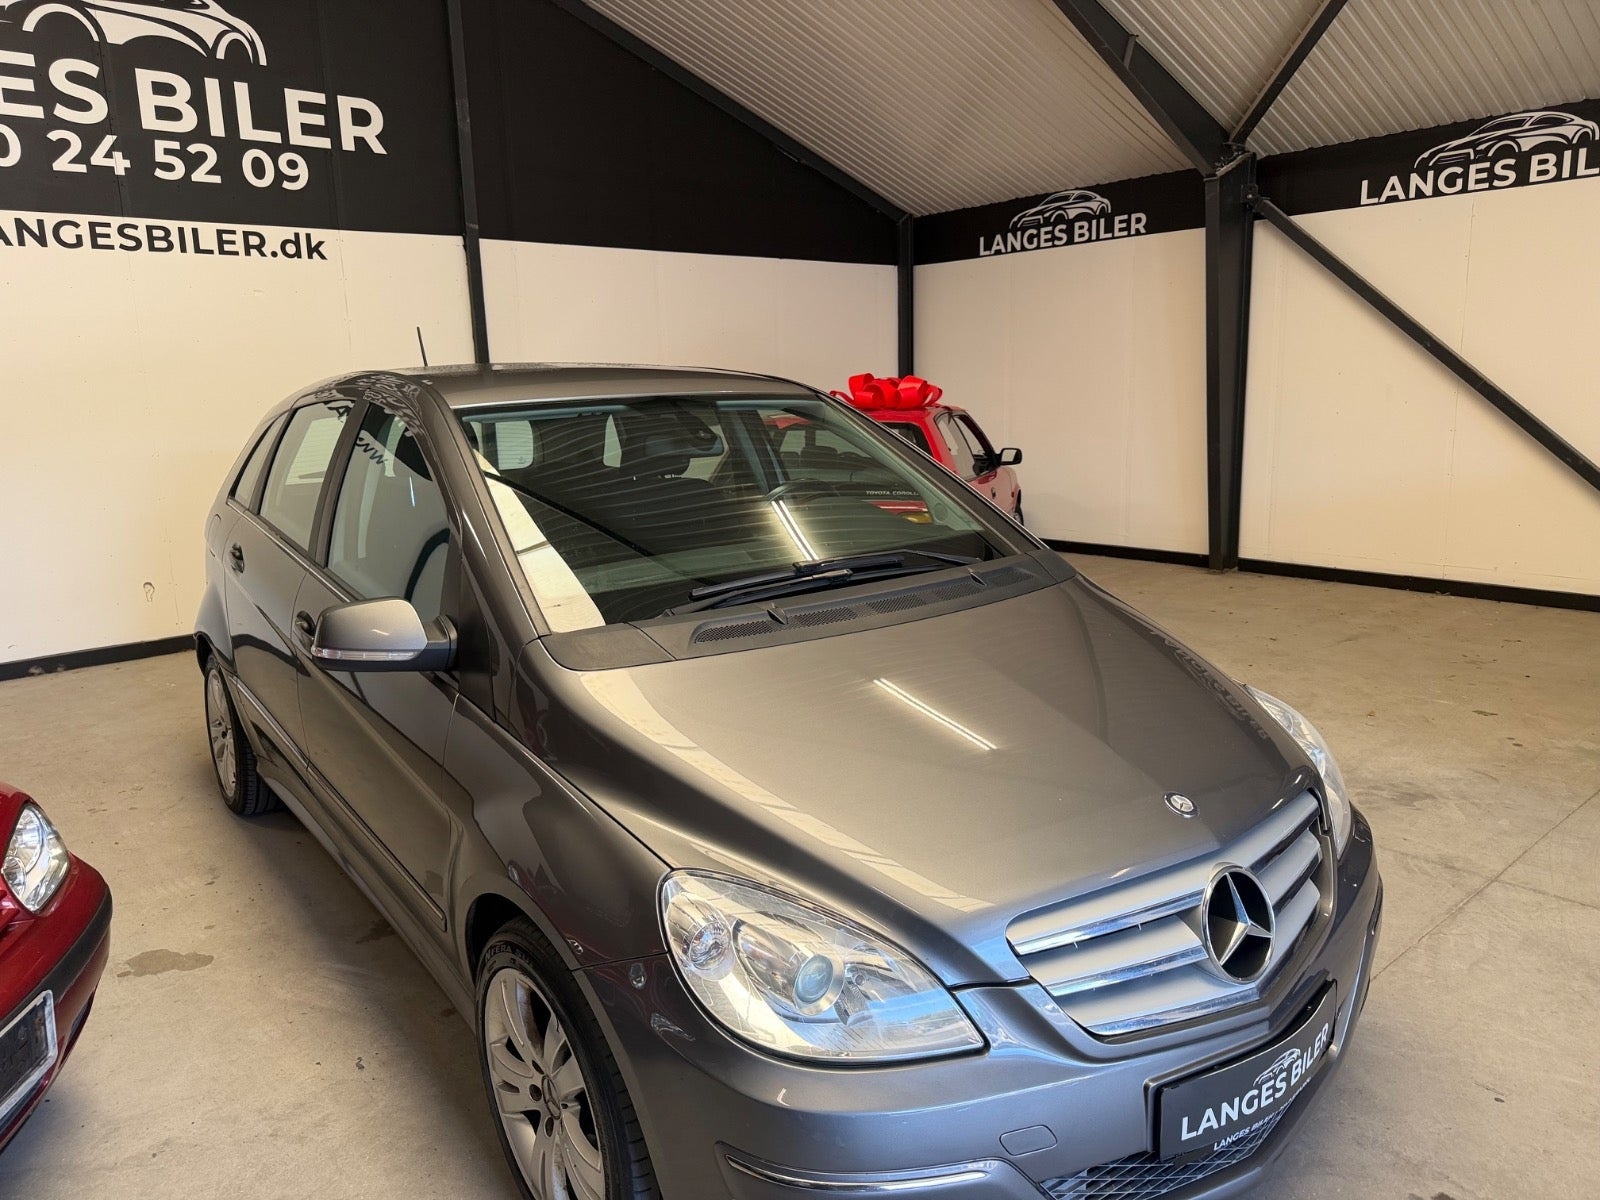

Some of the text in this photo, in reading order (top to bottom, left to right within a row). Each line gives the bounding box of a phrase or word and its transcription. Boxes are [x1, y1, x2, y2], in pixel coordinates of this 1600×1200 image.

[0, 49, 388, 155] ES BILER
[46, 129, 131, 176] 24
[154, 139, 222, 184] 52
[241, 148, 309, 191] 09
[1360, 146, 1600, 206] LANGES BIL
[979, 212, 1147, 257] LANGES BILER
[1181, 1070, 1288, 1141] LANGES
[1290, 1022, 1329, 1087] BILER
[1213, 1126, 1251, 1151] LANGES
